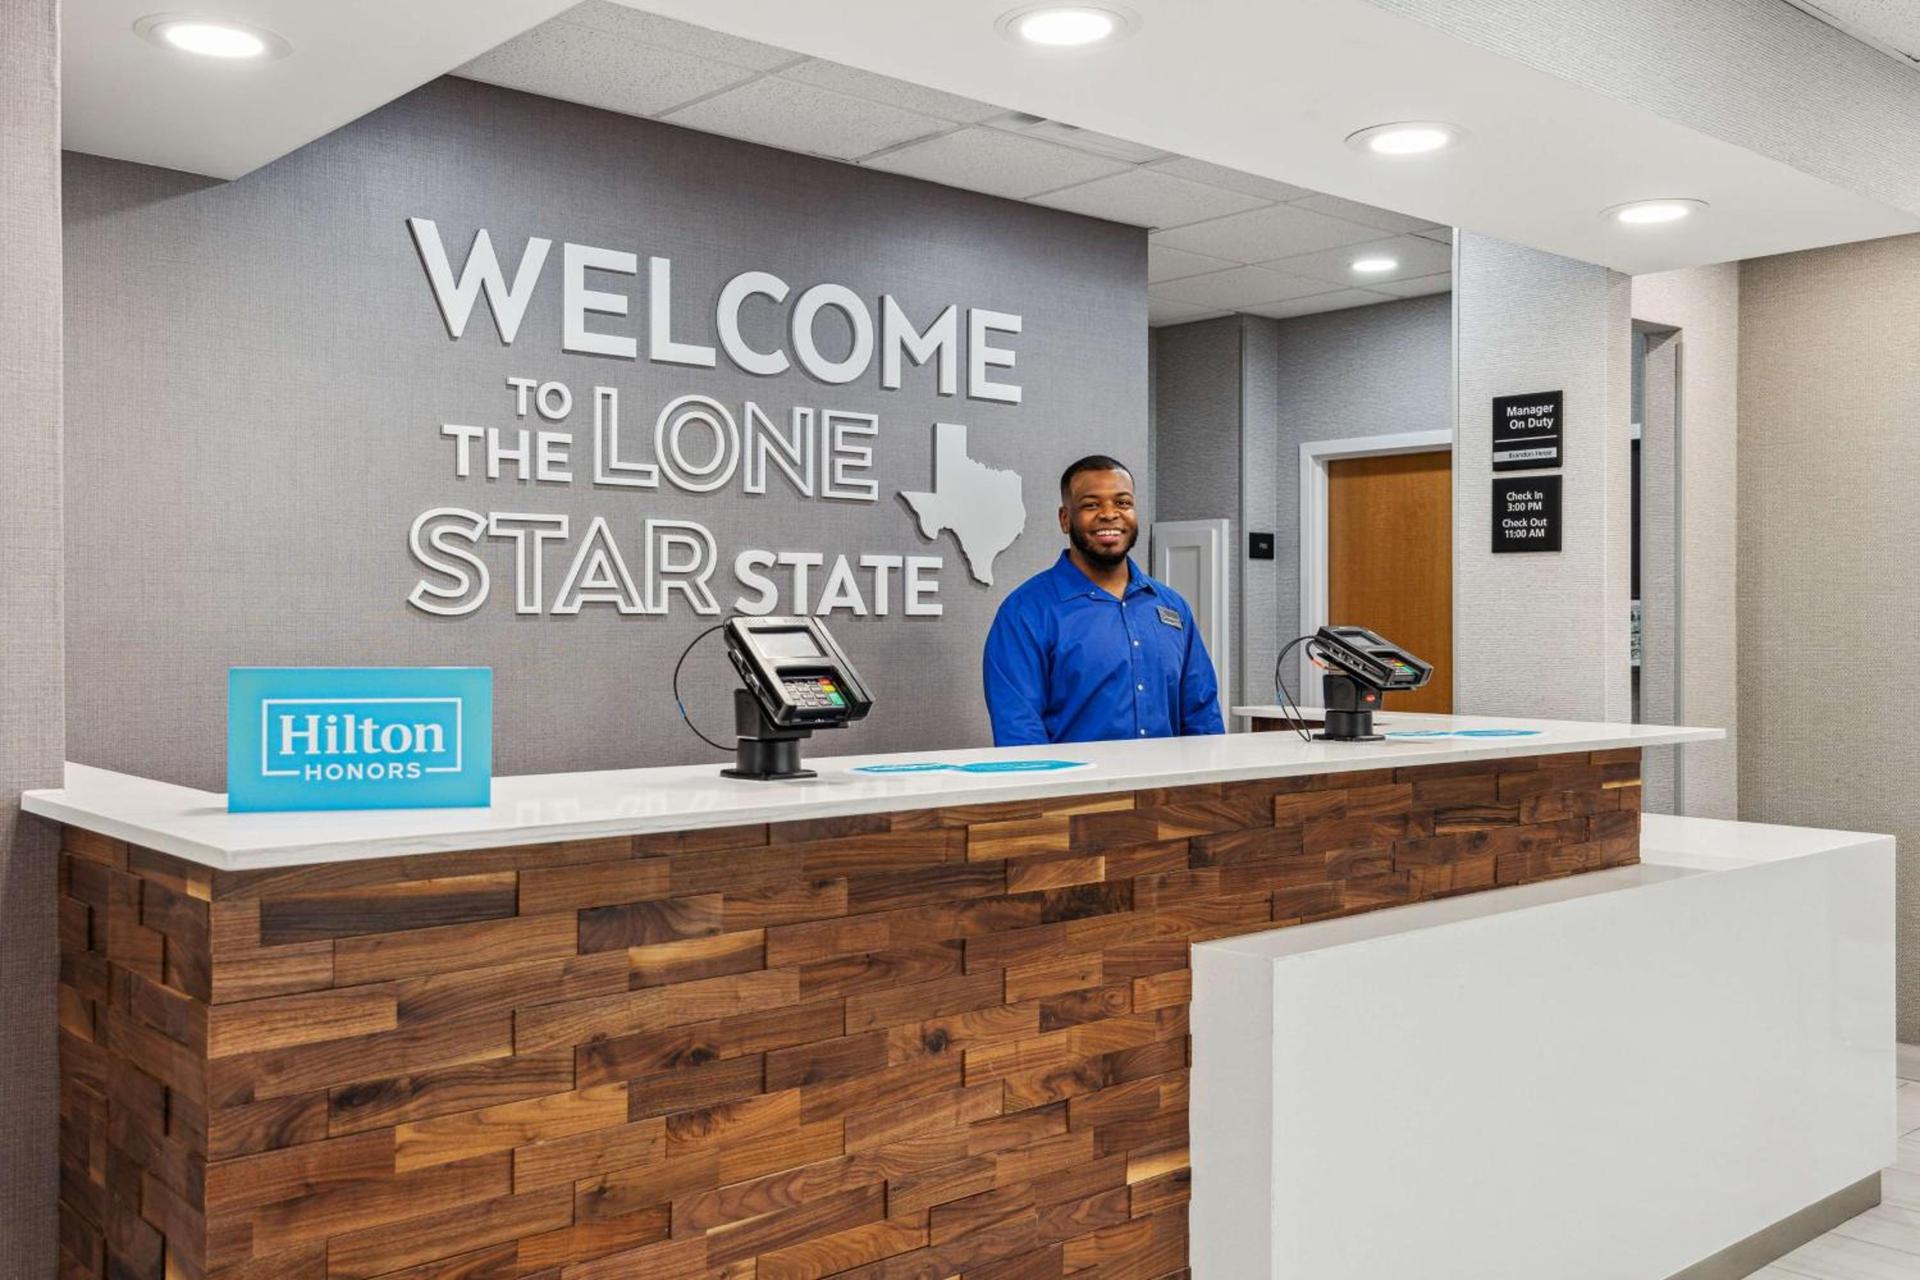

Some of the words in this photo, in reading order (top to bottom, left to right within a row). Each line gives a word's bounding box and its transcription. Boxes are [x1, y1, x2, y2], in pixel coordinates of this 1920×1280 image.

[406, 216, 1024, 404] WELCOME
[506, 376, 573, 420] TO
[1506, 404, 1554, 417] Manager
[1509, 419, 1525, 430] On
[1527, 417, 1554, 429] Duty
[440, 423, 573, 483] THE
[593, 385, 880, 502] LONE
[1506, 491, 1532, 501] Check
[1534, 491, 1543, 500] In
[1507, 502, 1526, 512] 3:00
[1527, 501, 1542, 511] PM
[1502, 518, 1528, 528] Check
[1530, 517, 1547, 527] Out
[1505, 529, 1527, 539] 11:00
[1528, 528, 1545, 538] AM
[406, 507, 722, 616] STAR
[733, 549, 944, 616] STATE
[279, 713, 446, 755] Hilton
[304, 762, 422, 781] HONORS
